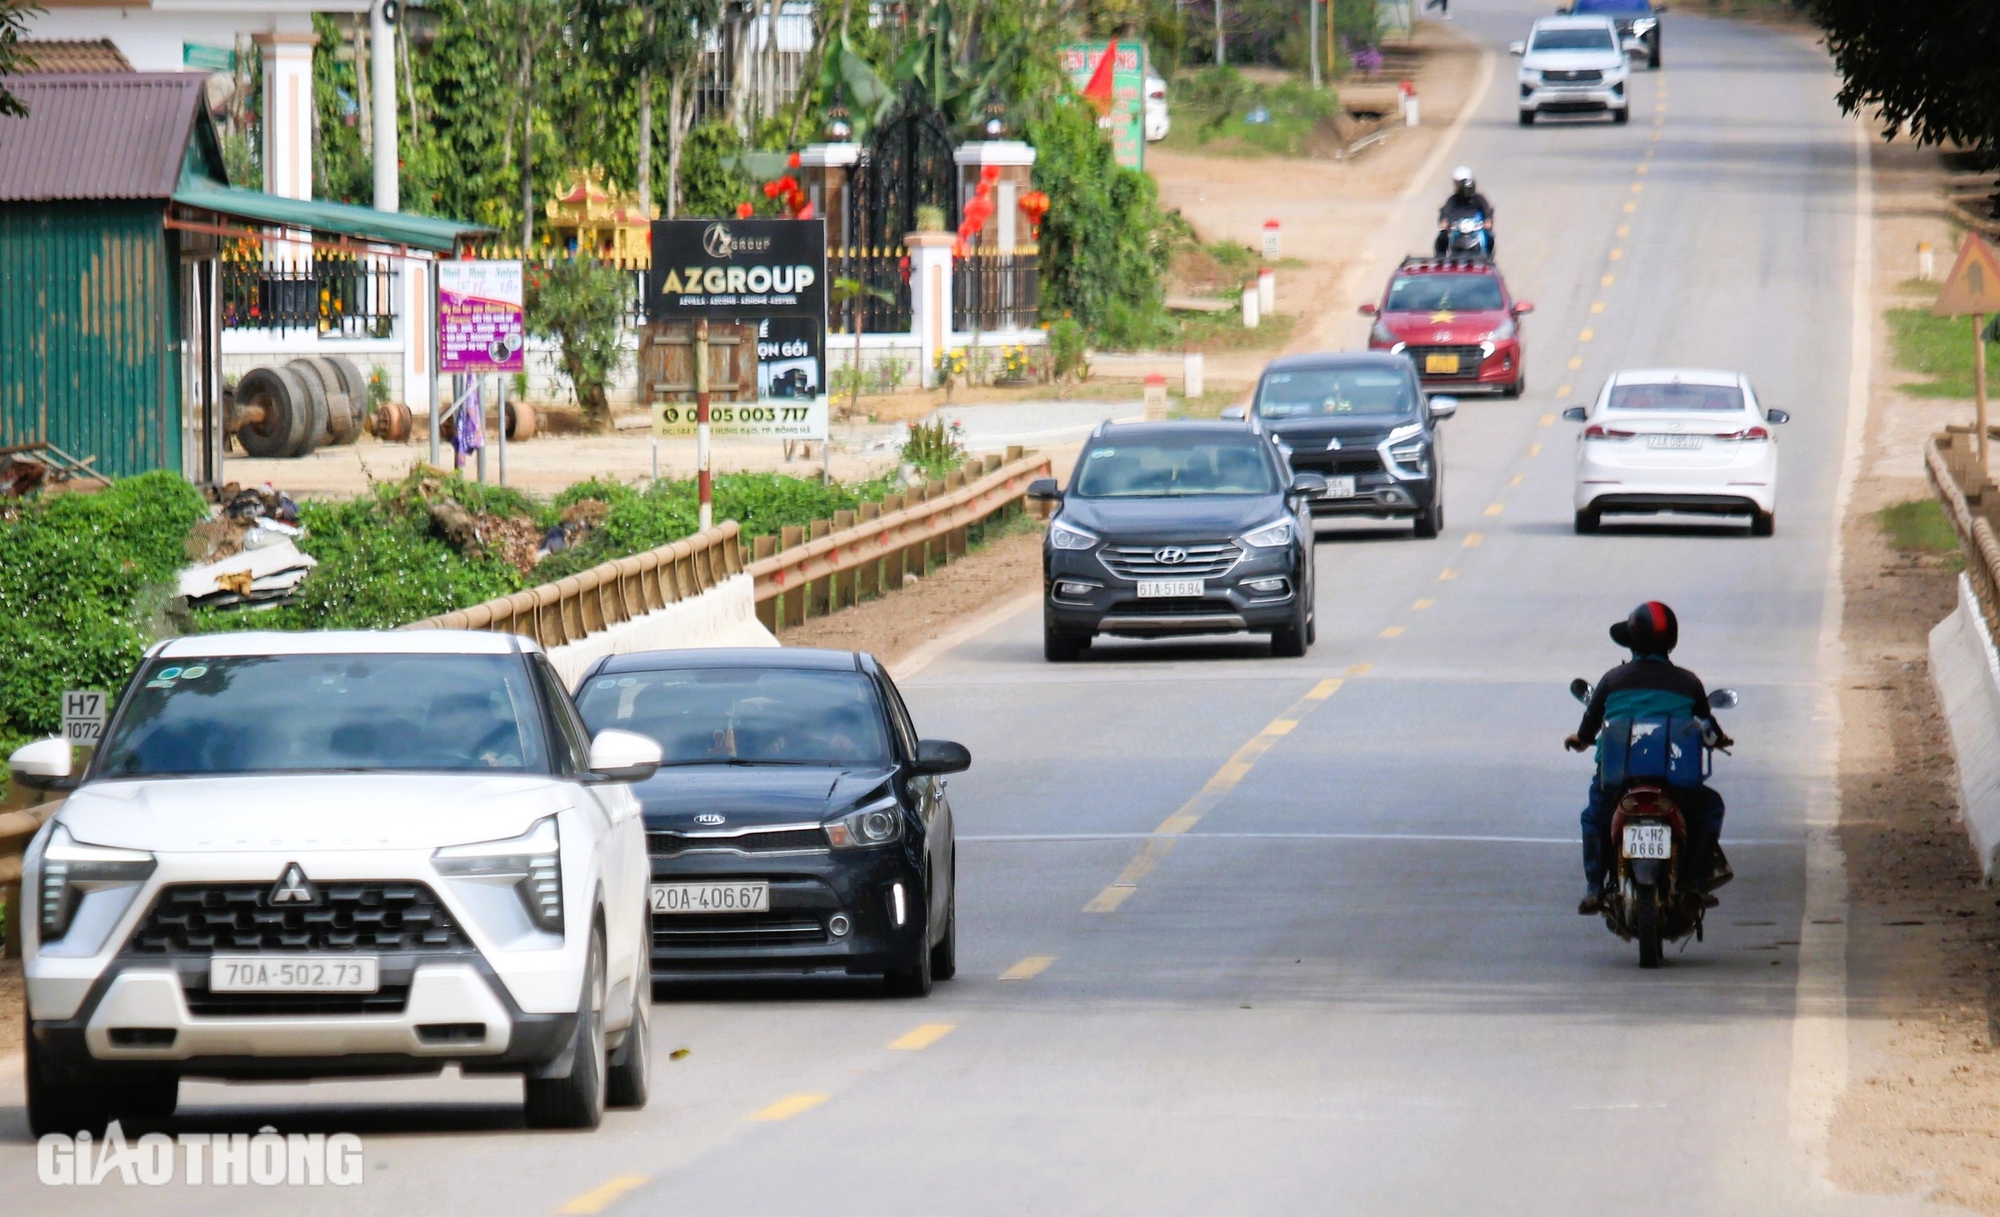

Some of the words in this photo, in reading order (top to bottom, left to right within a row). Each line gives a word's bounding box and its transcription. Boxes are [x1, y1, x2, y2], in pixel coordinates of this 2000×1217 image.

[731, 238, 771, 250] GROUP
[662, 265, 815, 294] AZGROUP
[781, 339, 808, 356] GÓI
[687, 408, 733, 422] 005
[740, 408, 775, 422] 003
[781, 408, 810, 422] 717
[1139, 583, 1201, 596] 61A-516.84
[68, 694, 99, 716] H7
[67, 722, 100, 739] 1072
[699, 814, 721, 823] KIA
[1630, 842, 1664, 856] 0666
[654, 886, 763, 910] 20A-406.67
[225, 964, 362, 986] 70A-502.73
